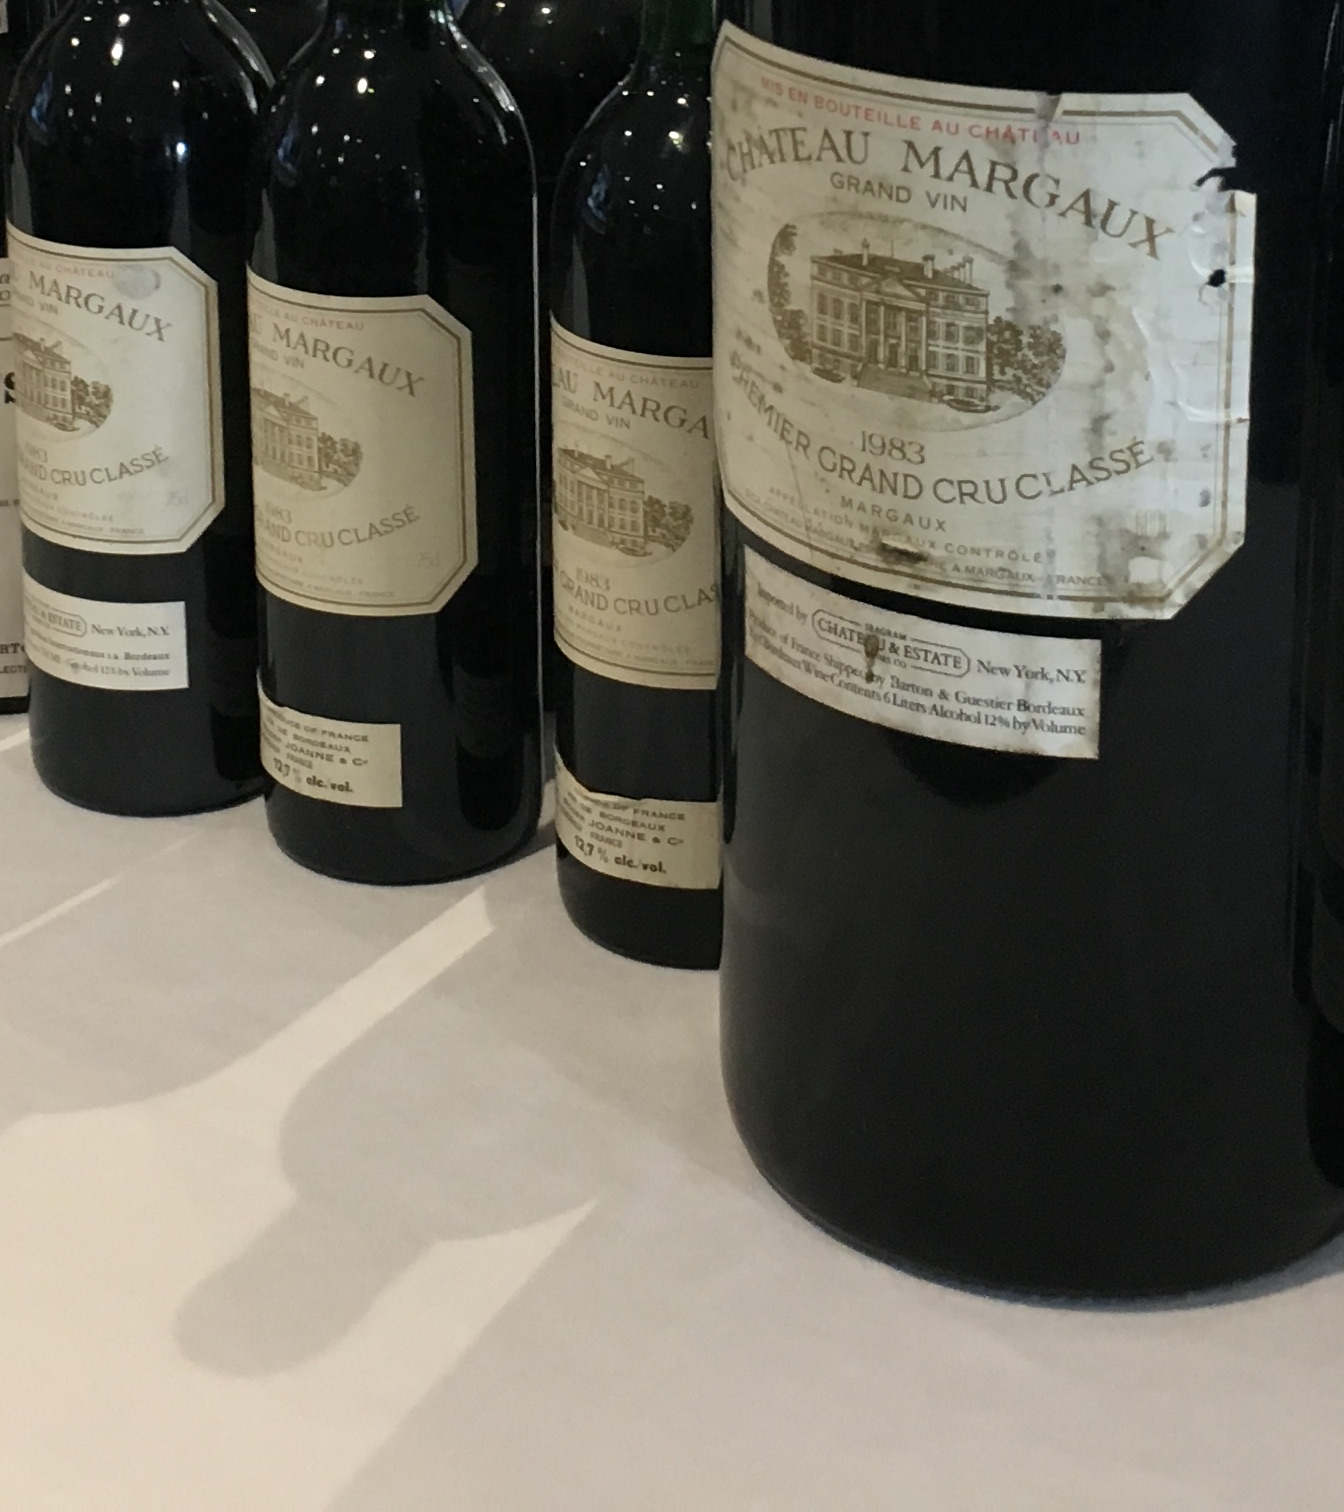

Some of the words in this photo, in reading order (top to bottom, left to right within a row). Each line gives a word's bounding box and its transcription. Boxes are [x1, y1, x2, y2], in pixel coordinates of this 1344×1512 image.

[760, 76, 783, 96] MIS
[788, 86, 808, 105] EN
[814, 95, 922, 131] BOUTEILLE
[931, 119, 960, 136] AU
[968, 124, 1080, 146] CHÂTAU
[829, 171, 913, 204] GRAND
[925, 190, 968, 213] VIN
[900, 140, 1175, 260] MARGAUX
[28, 270, 173, 342] MARGAUX
[272, 321, 424, 397] MARGAUX
[592, 380, 710, 440] MARGA
[607, 414, 631, 430] VIN
[729, 349, 811, 460] PREMIER
[817, 445, 924, 501] GRAND
[932, 477, 1007, 505] CRU
[860, 430, 926, 465] 1983
[51, 468, 87, 487] CRU
[840, 495, 947, 532] MARGAUX
[294, 530, 335, 548] CRU
[964, 564, 1034, 583] MARGAUX
[560, 570, 608, 611] GRAND
[613, 597, 659, 616] CRU
[757, 582, 794, 615] Imported
[796, 605, 807, 624] by
[817, 617, 886, 652] CHATEU
[888, 642, 900, 655] &
[903, 645, 963, 669] ESTATE
[976, 659, 1011, 676] New
[1013, 664, 1055, 684] York,
[792, 637, 821, 661] France
[890, 675, 933, 697] Barton
[937, 689, 949, 701] &
[955, 691, 1015, 711] Guestier
[1016, 699, 1085, 717] Bordeaux
[883, 692, 891, 704] 6
[892, 694, 927, 714] Liters
[929, 704, 981, 725] Alcohol
[985, 715, 1010, 728] 12%
[1012, 715, 1030, 734] by
[1032, 718, 1086, 735] Volume
[286, 742, 334, 762] JOANNE
[293, 733, 351, 753] BORDEAUX
[321, 730, 369, 742] FRANCE
[330, 781, 353, 793] vol.
[588, 820, 646, 842] JOANNE
[599, 812, 665, 832] BORDEAUX
[633, 808, 686, 821] FRANCE
